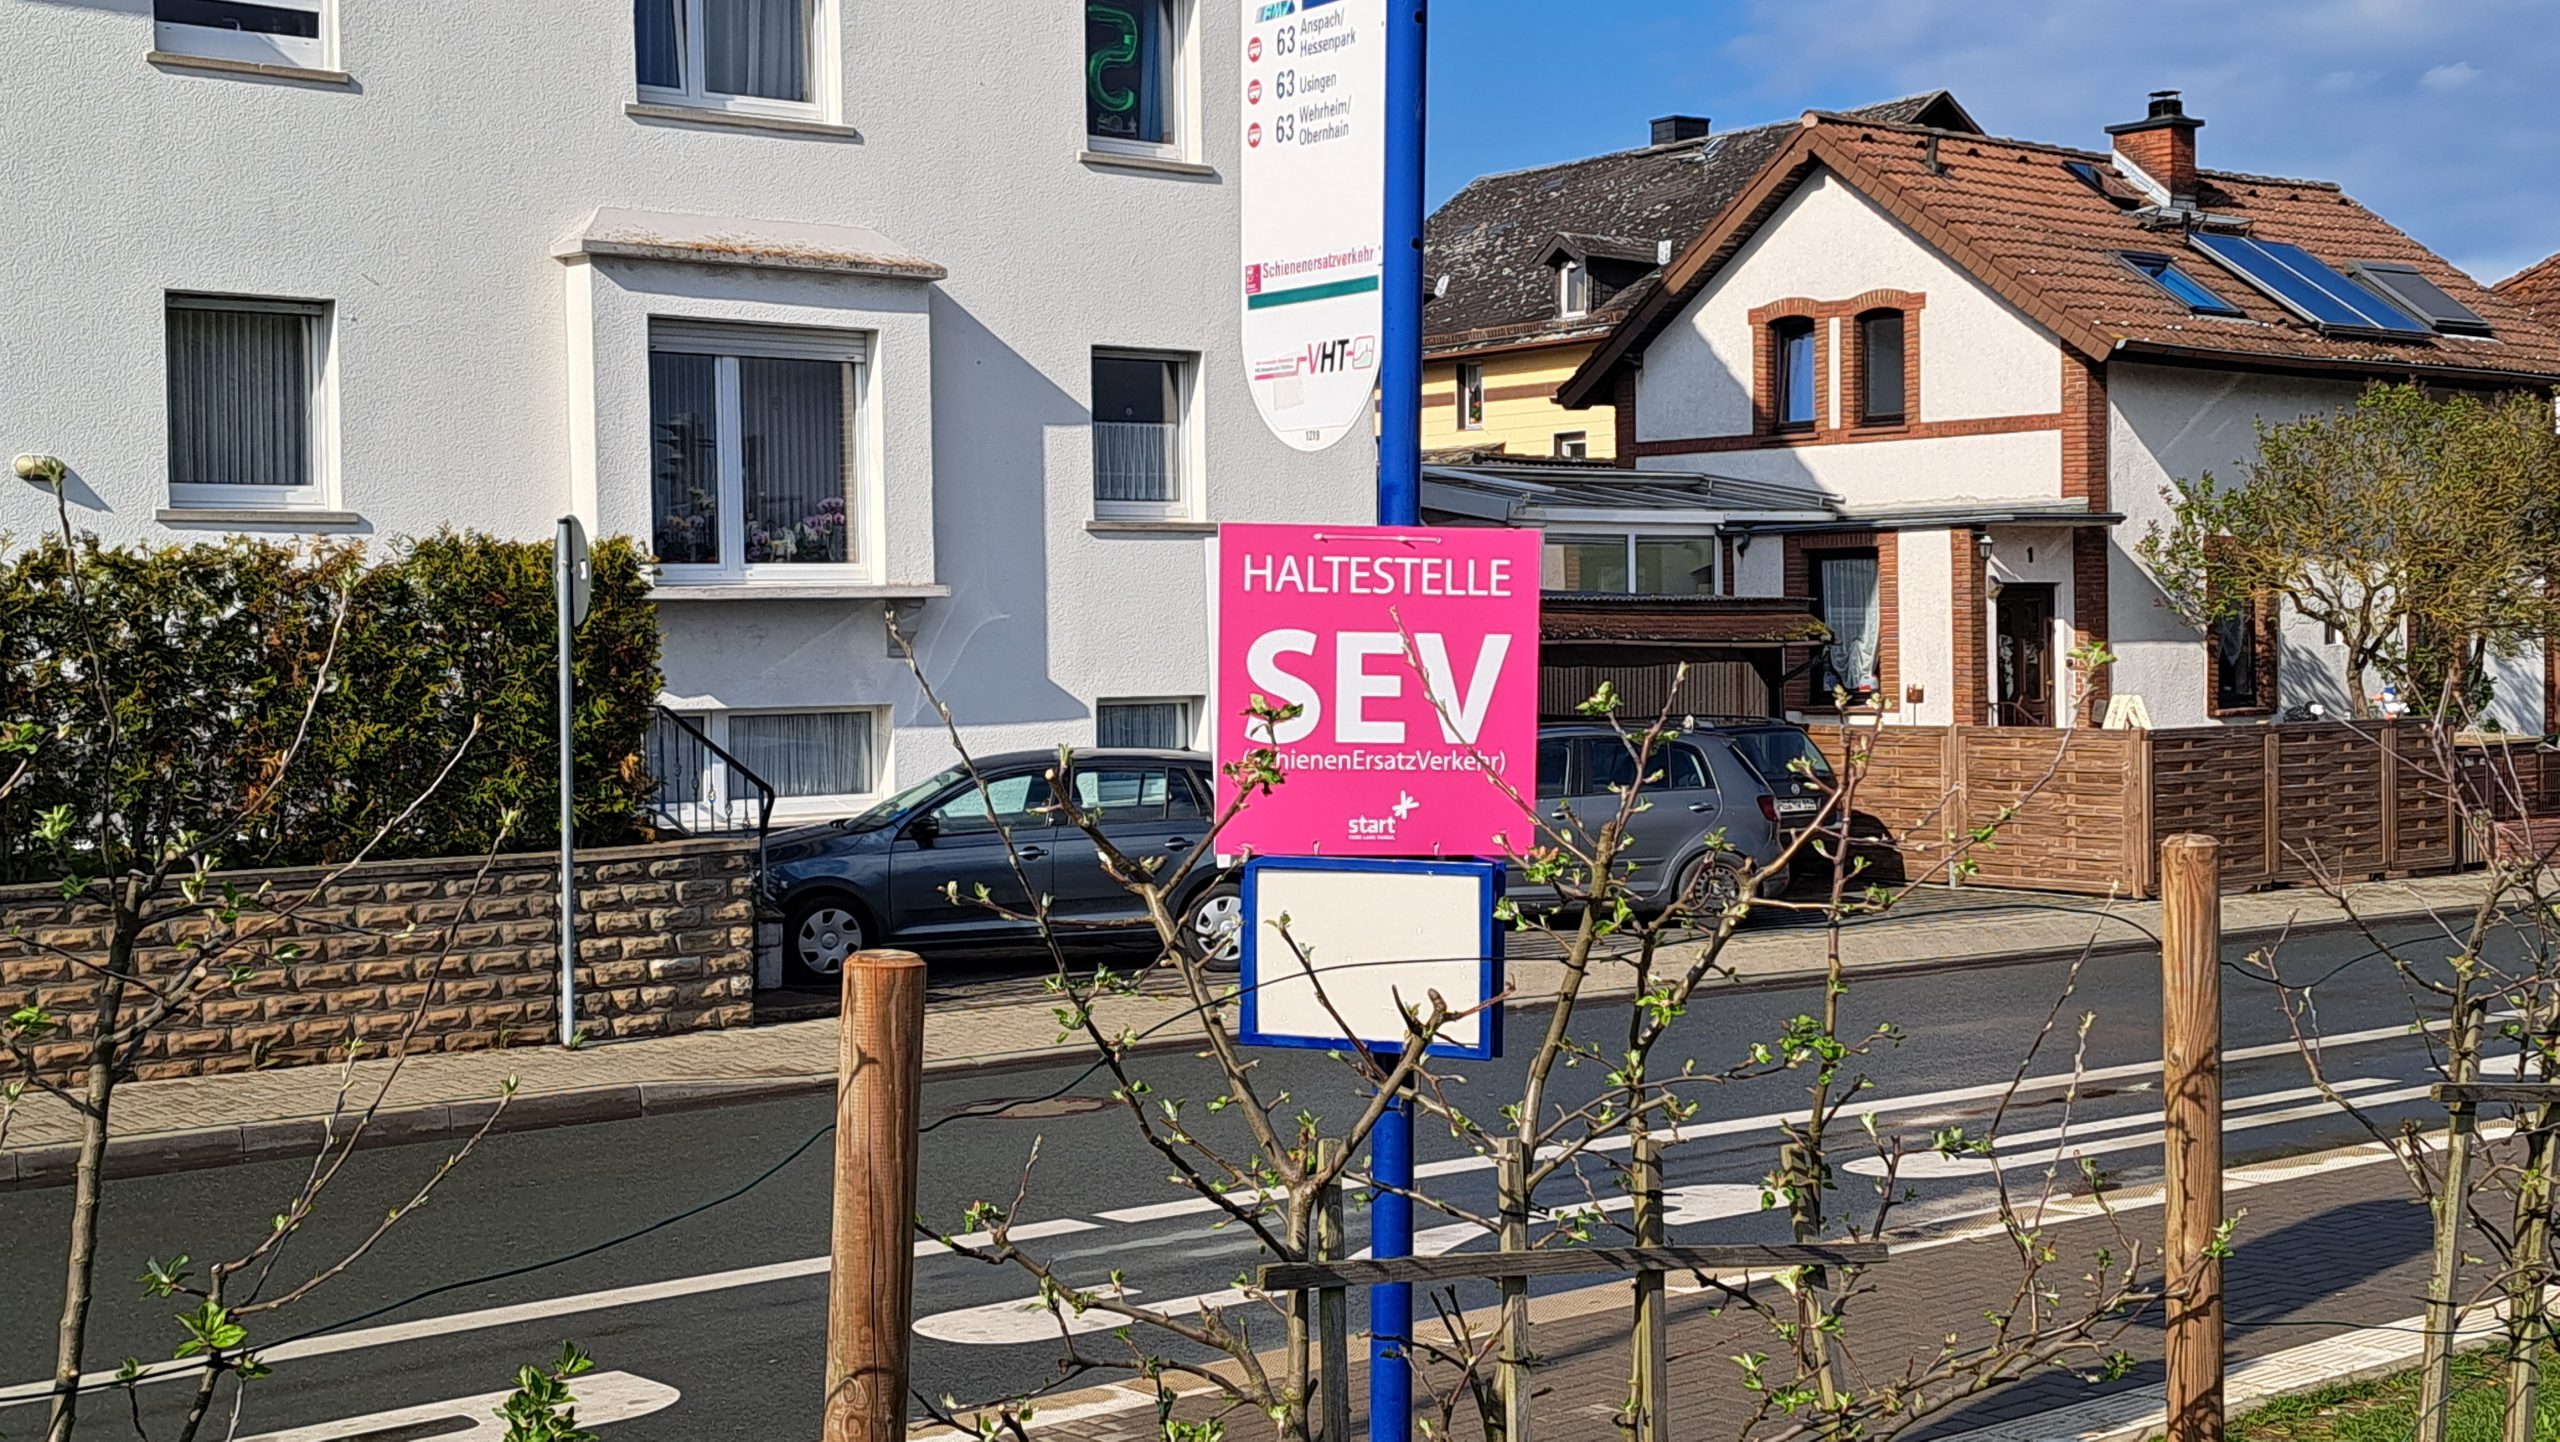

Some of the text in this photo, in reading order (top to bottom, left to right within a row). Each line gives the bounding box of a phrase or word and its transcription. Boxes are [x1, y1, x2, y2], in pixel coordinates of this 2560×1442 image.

[1300, 7, 1345, 35] Anspach/
[1277, 26, 1295, 56] 63
[1300, 28, 1356, 57] Hessenpark
[1276, 69, 1337, 100] 63 Usingen
[1299, 94, 1352, 124] Wehrheim/
[1276, 113, 1294, 143] 63
[1300, 120, 1349, 146] Obernhain
[1263, 245, 1374, 279] Schienenersatzverkehr
[1307, 338, 1350, 375] VHT
[2026, 546, 2034, 563] 1
[1243, 554, 1512, 597] HALTESTELLE
[1243, 628, 1513, 745] SEV
[1347, 814, 1396, 834] start
